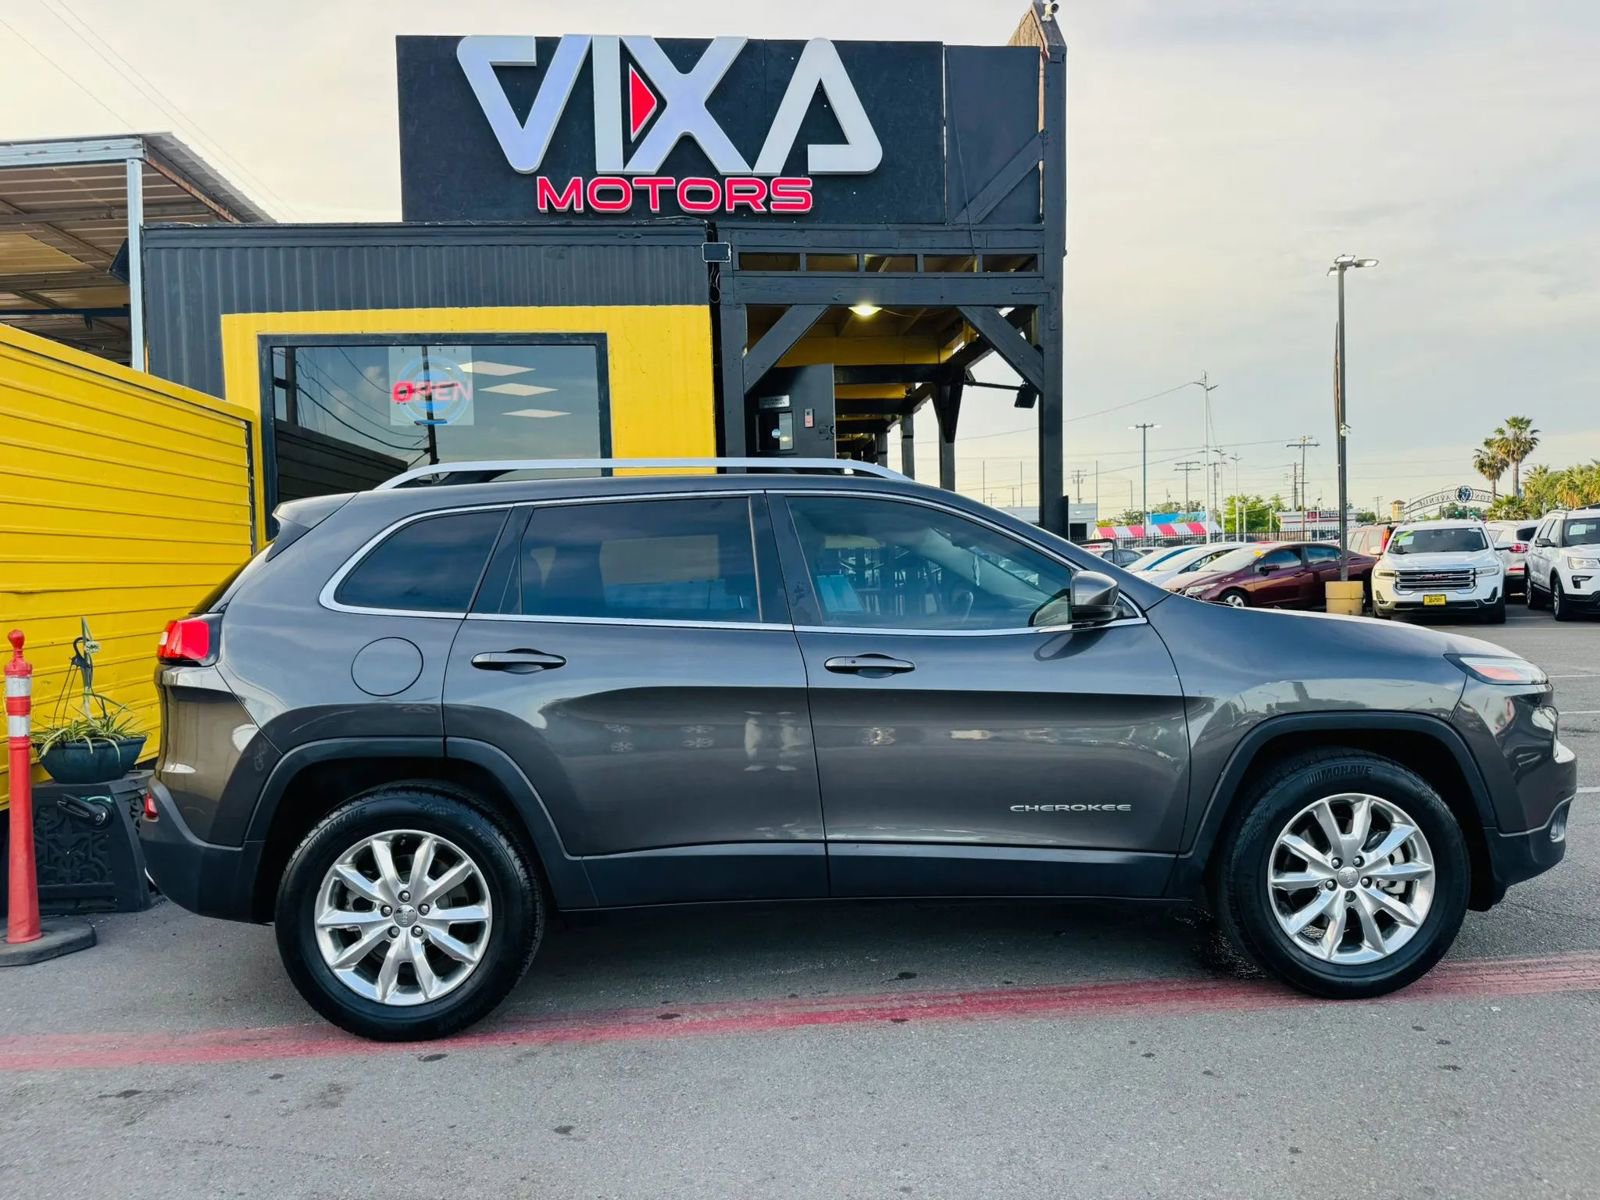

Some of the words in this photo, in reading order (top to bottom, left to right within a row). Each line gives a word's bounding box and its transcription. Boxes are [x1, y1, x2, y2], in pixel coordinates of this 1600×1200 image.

[457, 35, 882, 175] VIXA
[537, 177, 813, 213] MOTORS
[392, 381, 473, 402] OPEN
[1322, 766, 1374, 781] MOHAVE
[1009, 803, 1133, 812] CHEROKEE
